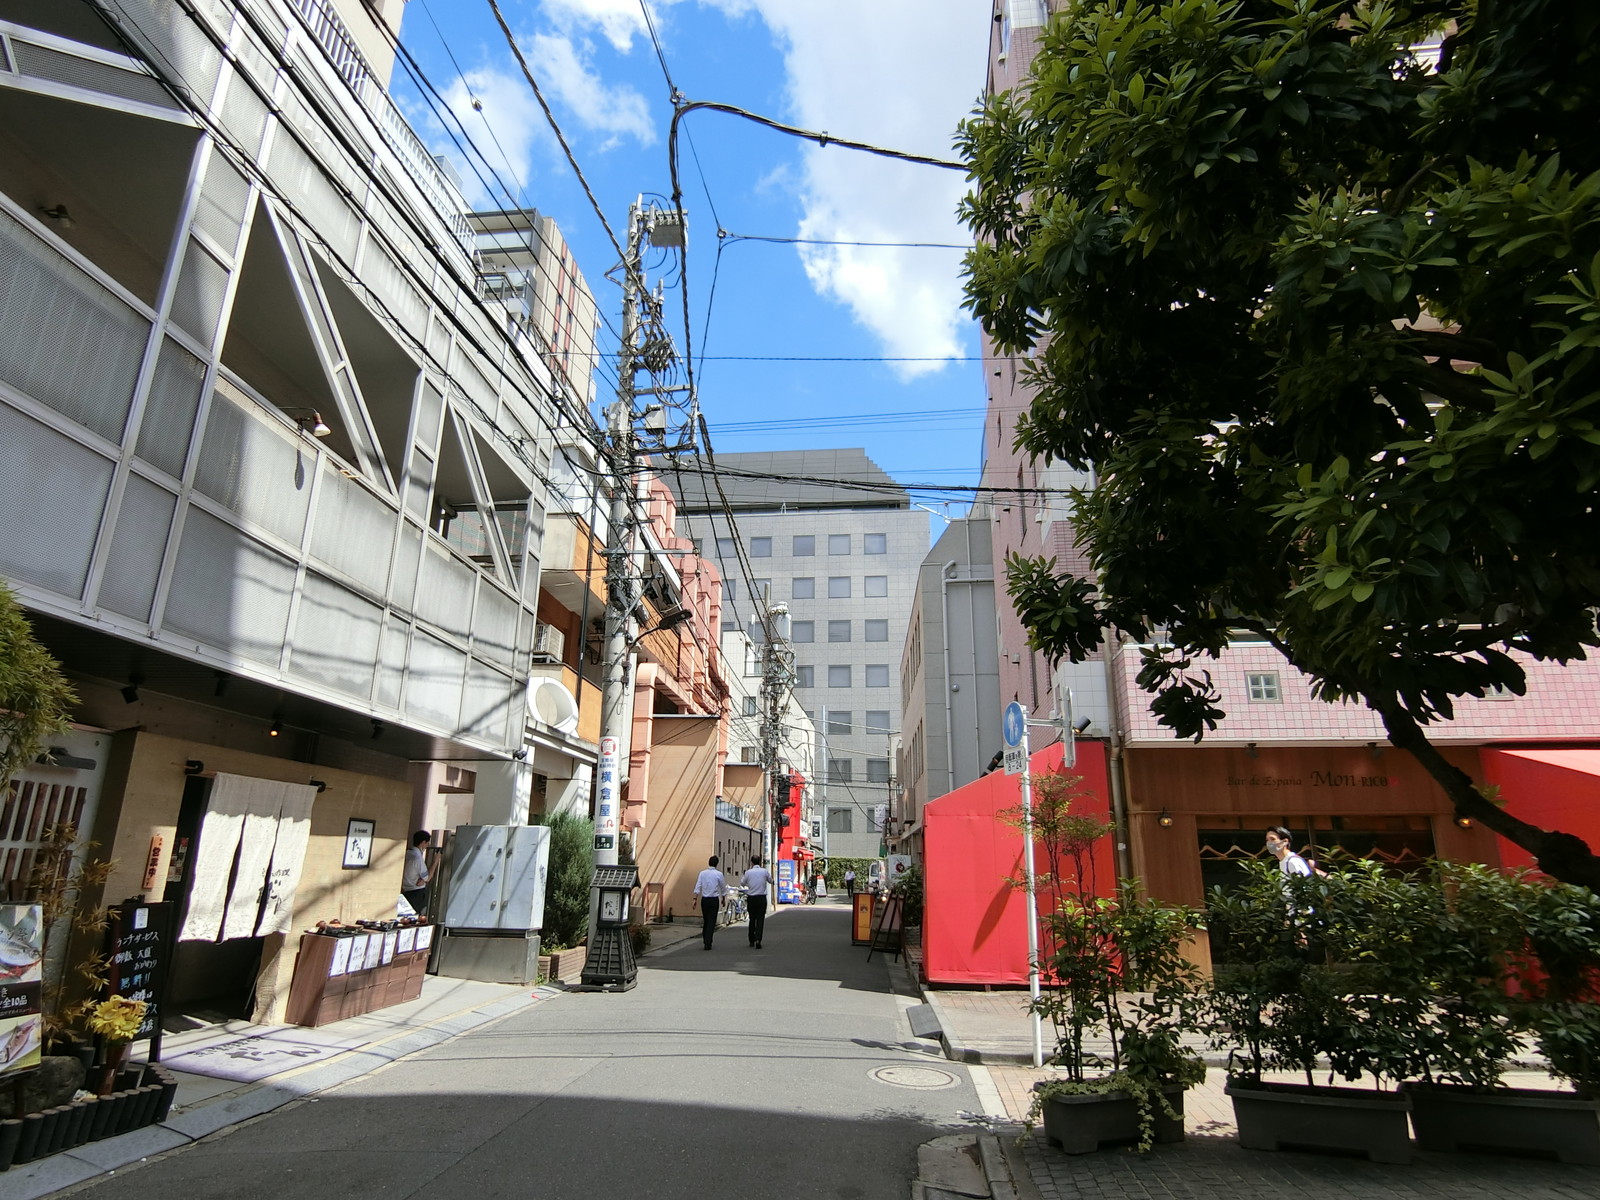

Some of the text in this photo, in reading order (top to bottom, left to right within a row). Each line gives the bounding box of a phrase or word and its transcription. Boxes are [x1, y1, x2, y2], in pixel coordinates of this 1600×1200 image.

[1226, 775, 1246, 786] Bar
[1249, 775, 1260, 786] de
[599, 770, 612, 817] 横倉屋
[116, 931, 160, 948] ランチサービス
